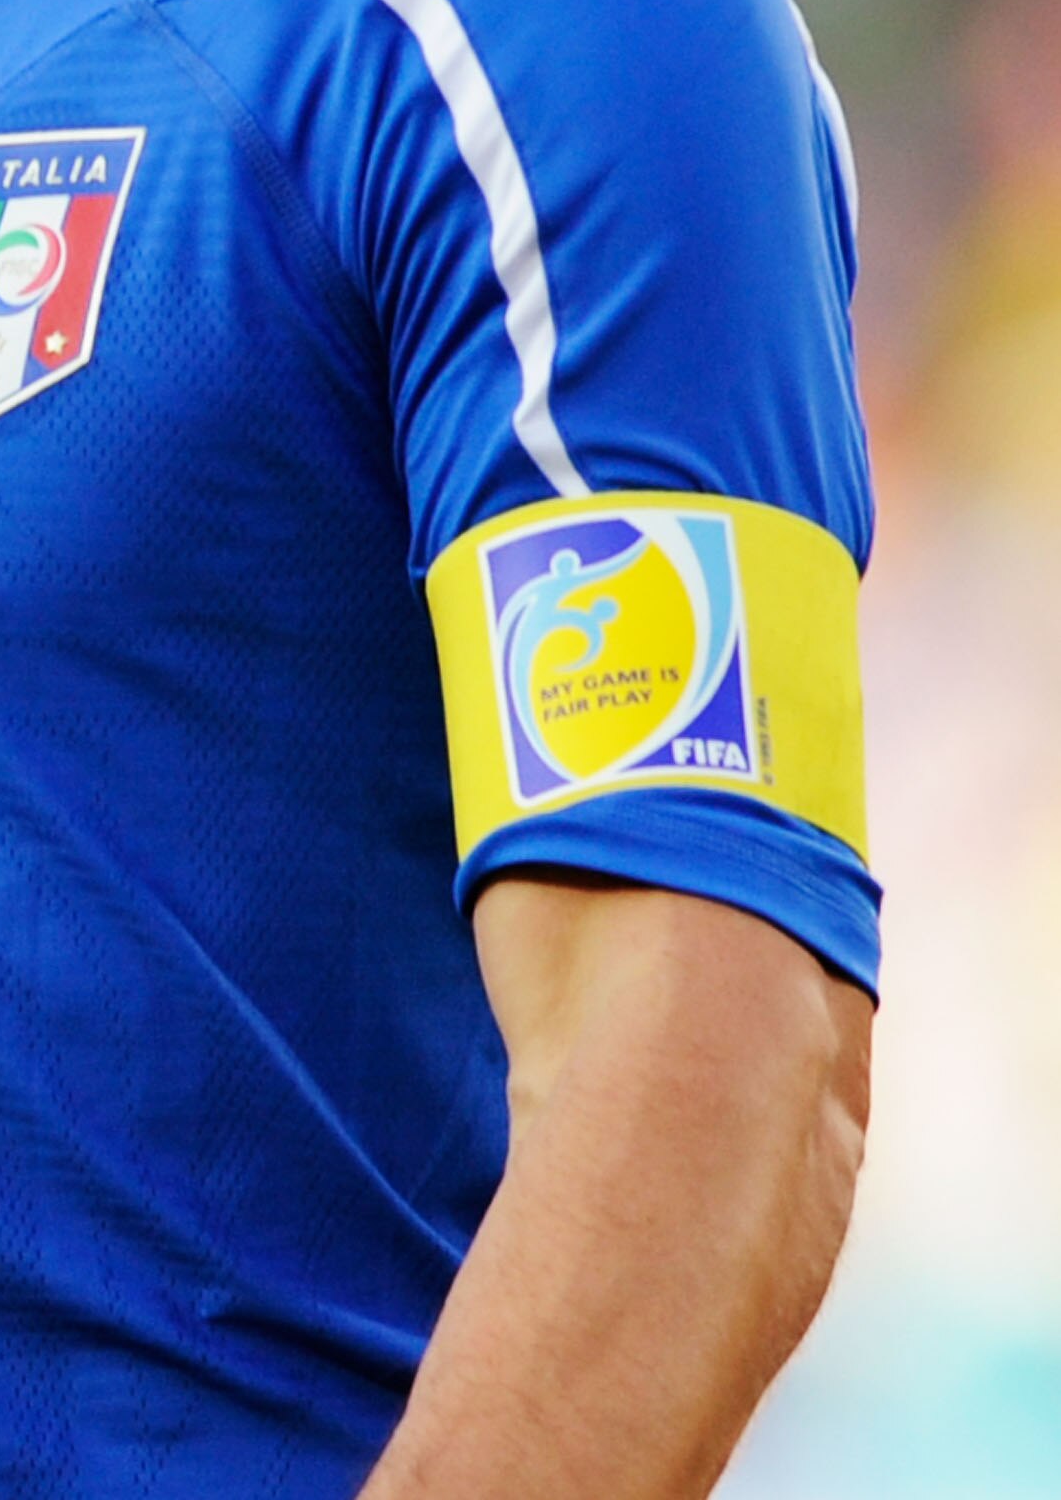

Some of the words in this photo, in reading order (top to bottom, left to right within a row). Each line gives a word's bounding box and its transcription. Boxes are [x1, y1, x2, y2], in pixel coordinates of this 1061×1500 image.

[540, 681, 573, 703] MY
[583, 667, 651, 691] GAME
[660, 667, 681, 682] IS
[542, 698, 589, 724] FAIR
[597, 689, 653, 710] PLAY
[671, 736, 747, 770] FIFA
